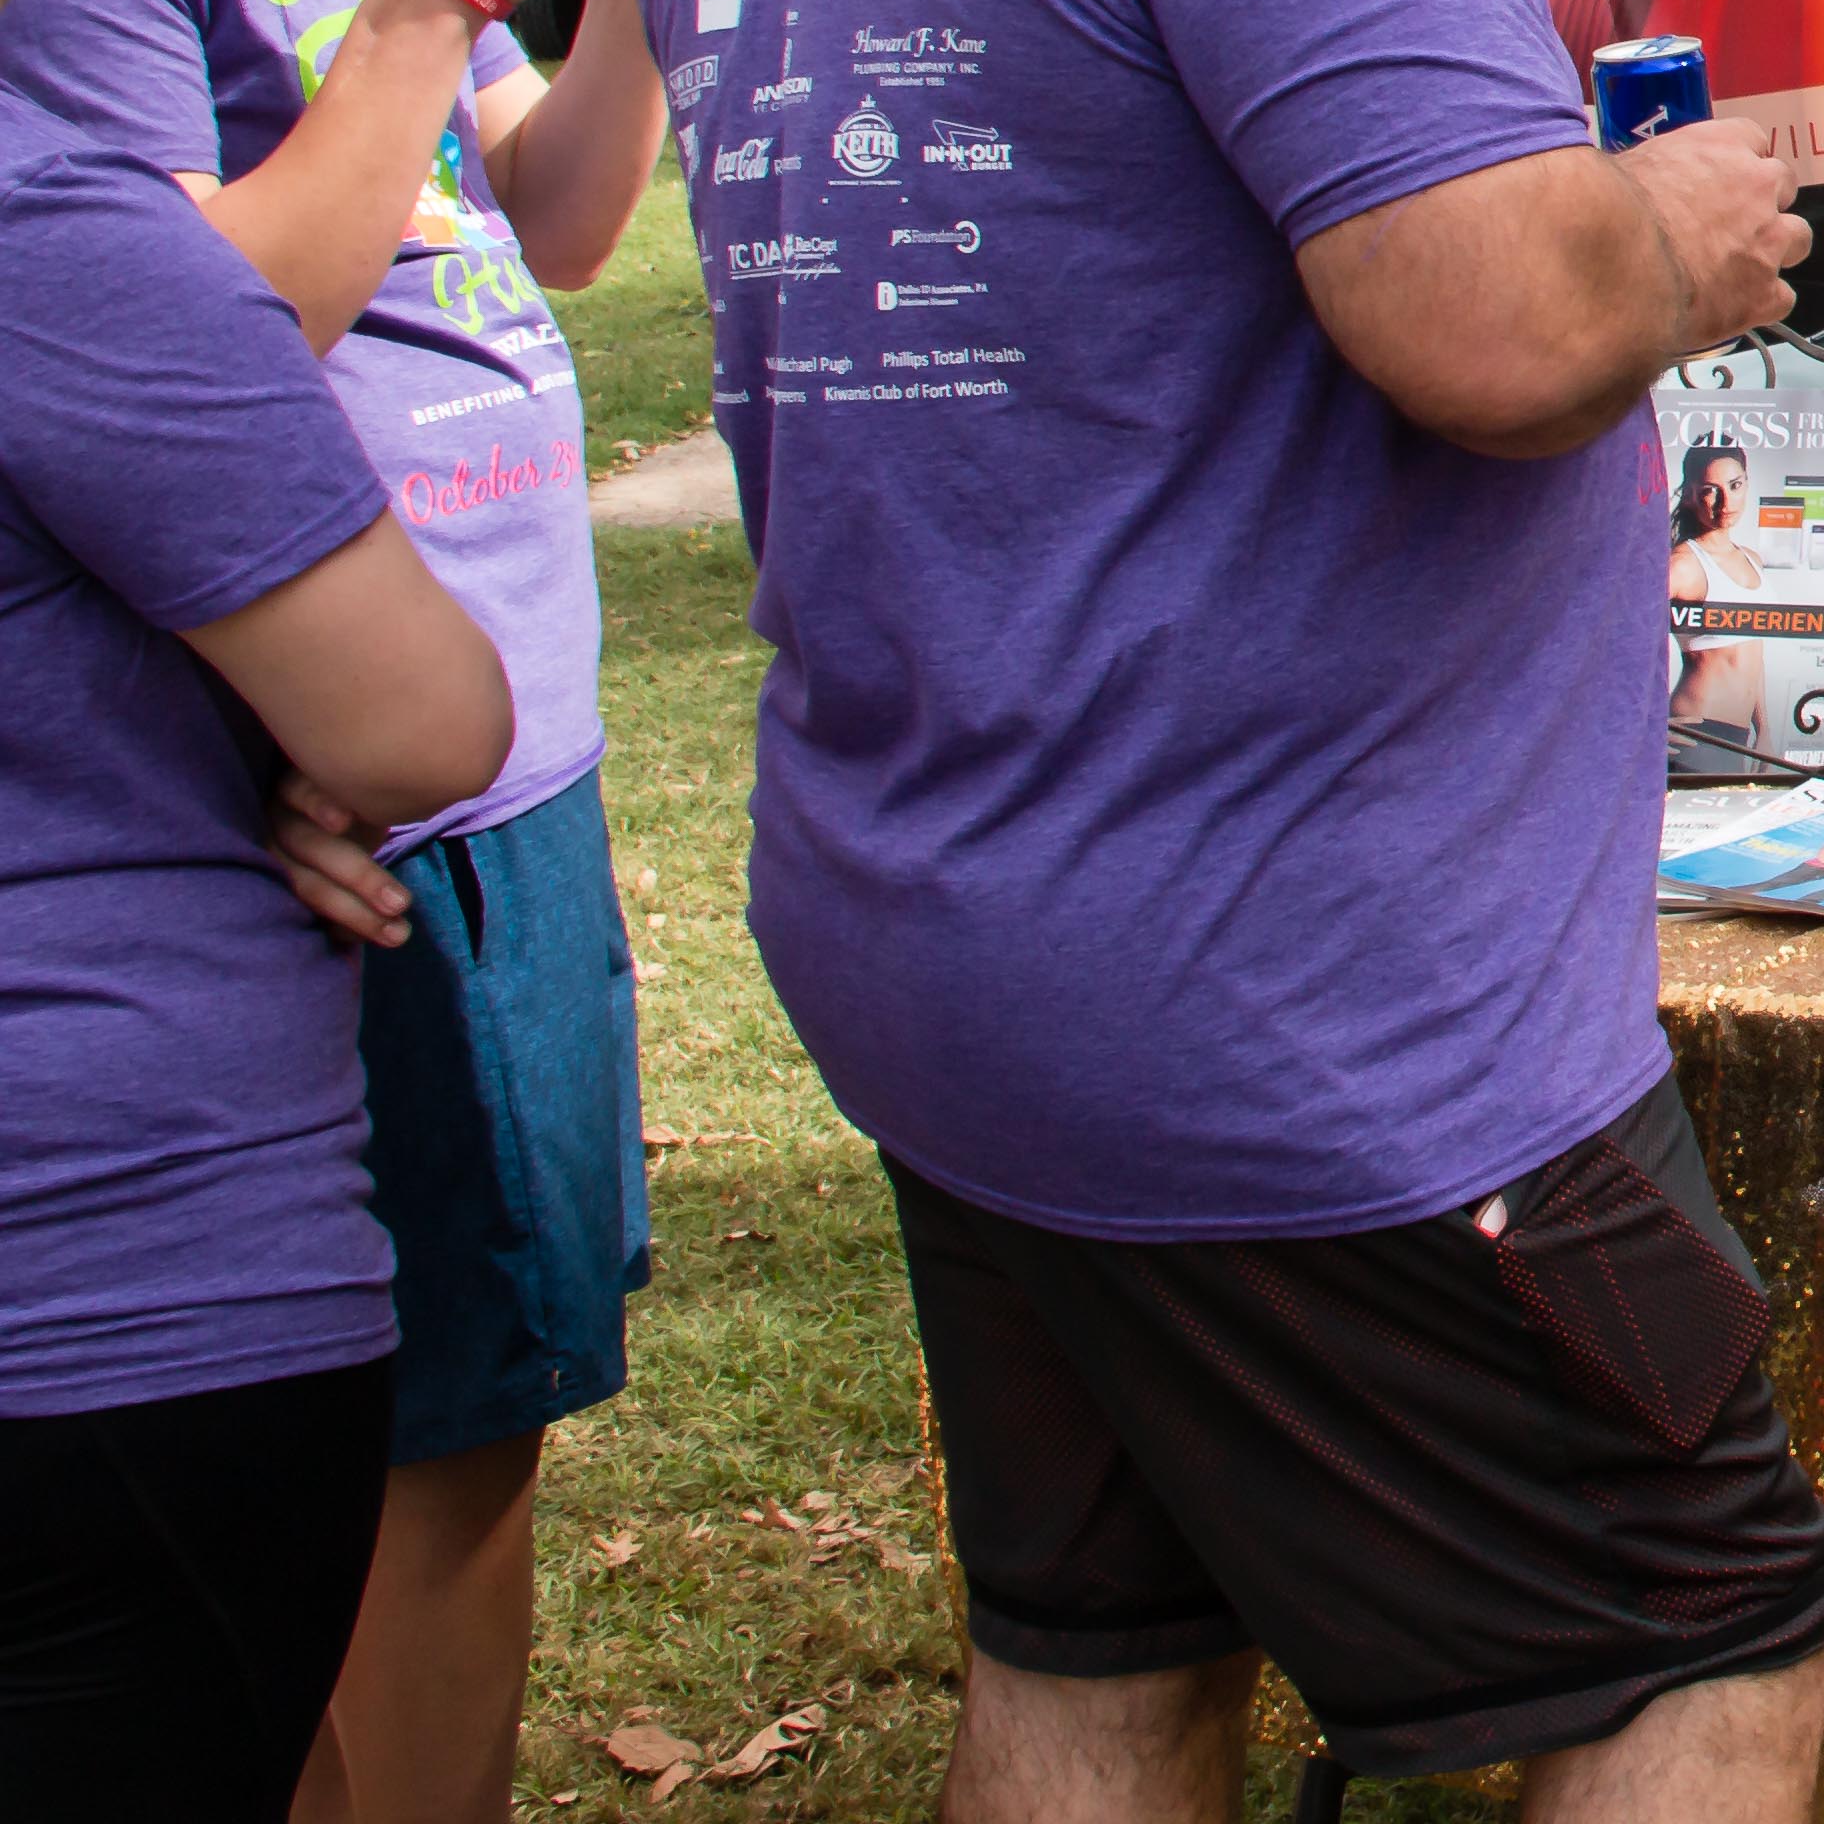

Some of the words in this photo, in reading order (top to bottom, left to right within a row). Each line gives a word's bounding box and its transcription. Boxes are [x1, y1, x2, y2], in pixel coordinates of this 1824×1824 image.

[851, 25, 915, 55] Howard
[913, 27, 936, 58] F.
[939, 28, 987, 55] Kane
[832, 130, 901, 161] KEITH
[882, 350, 929, 370] Phillips
[931, 348, 970, 366] Total
[972, 346, 1027, 364] Health
[411, 385, 526, 427] BENEFITING
[823, 385, 872, 402] Kiwanis
[872, 384, 903, 401] Club
[904, 383, 920, 399] of
[921, 383, 953, 400] Fort
[954, 377, 1009, 398] Worth
[1655, 409, 1790, 450] CCESS
[401, 442, 543, 526] October
